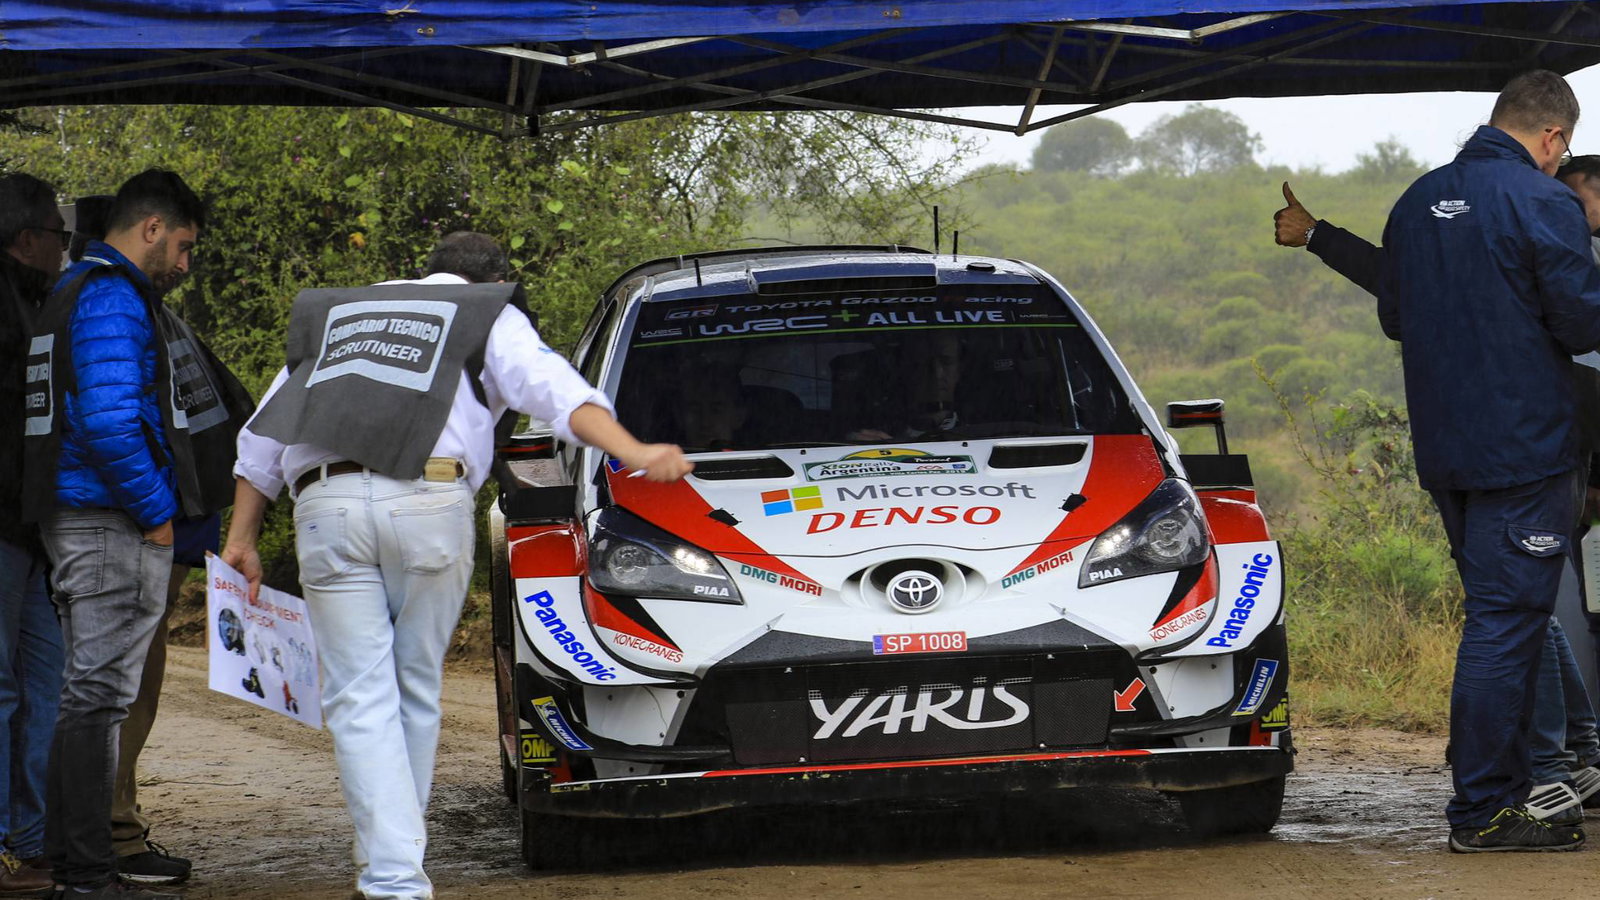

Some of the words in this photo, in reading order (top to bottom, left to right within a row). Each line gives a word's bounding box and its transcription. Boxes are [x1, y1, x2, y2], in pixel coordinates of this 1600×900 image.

[668, 308, 714, 319] GR
[725, 299, 833, 313] TOYOTA
[840, 296, 937, 305] GAZOO
[867, 311, 927, 325] ALL
[935, 310, 1006, 323] LIVE
[328, 318, 389, 345] COMISARIO
[388, 318, 441, 344] TECNICO
[326, 339, 423, 363] SCRUTINEER
[820, 465, 902, 476] Argentina
[836, 482, 1037, 501] Microsoft
[806, 505, 1001, 535] DENSO
[740, 564, 778, 584] DMG
[779, 576, 822, 597] MORI
[1001, 567, 1035, 590] DMG
[1037, 551, 1074, 575] MORI
[1089, 567, 1123, 582] PIAA
[214, 577, 248, 599] SAFETY
[693, 585, 730, 596] PIAA
[1206, 553, 1273, 648] Panasonic
[524, 589, 616, 682] Panasonic
[1149, 608, 1207, 642] KONECRANES
[613, 632, 684, 664] KONECRANES
[886, 635, 912, 652] SP
[919, 633, 963, 650] 1008
[1247, 666, 1270, 705] MICHELIN
[549, 718, 584, 748] MICHELIN
